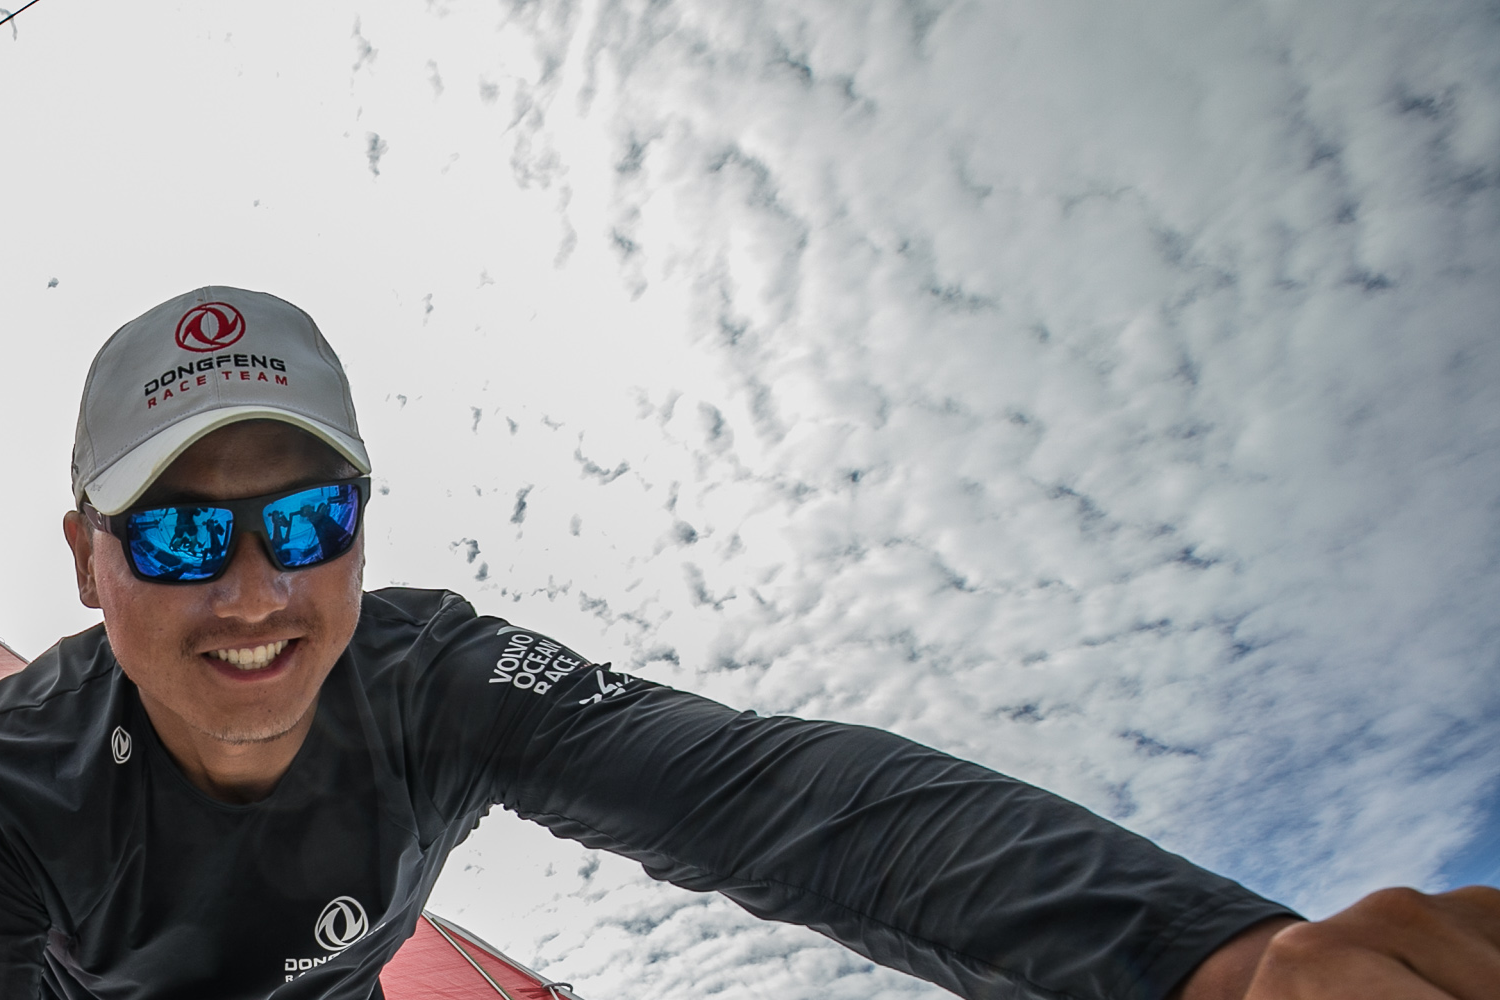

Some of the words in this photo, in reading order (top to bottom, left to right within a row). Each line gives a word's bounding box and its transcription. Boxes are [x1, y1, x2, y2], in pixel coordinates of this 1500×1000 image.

[144, 353, 287, 397] DONGFENG
[147, 374, 207, 409] RACE
[221, 371, 289, 386] TEAM
[489, 634, 534, 684] VOLVO
[512, 639, 563, 690] OCEAN
[533, 654, 581, 695] RACE
